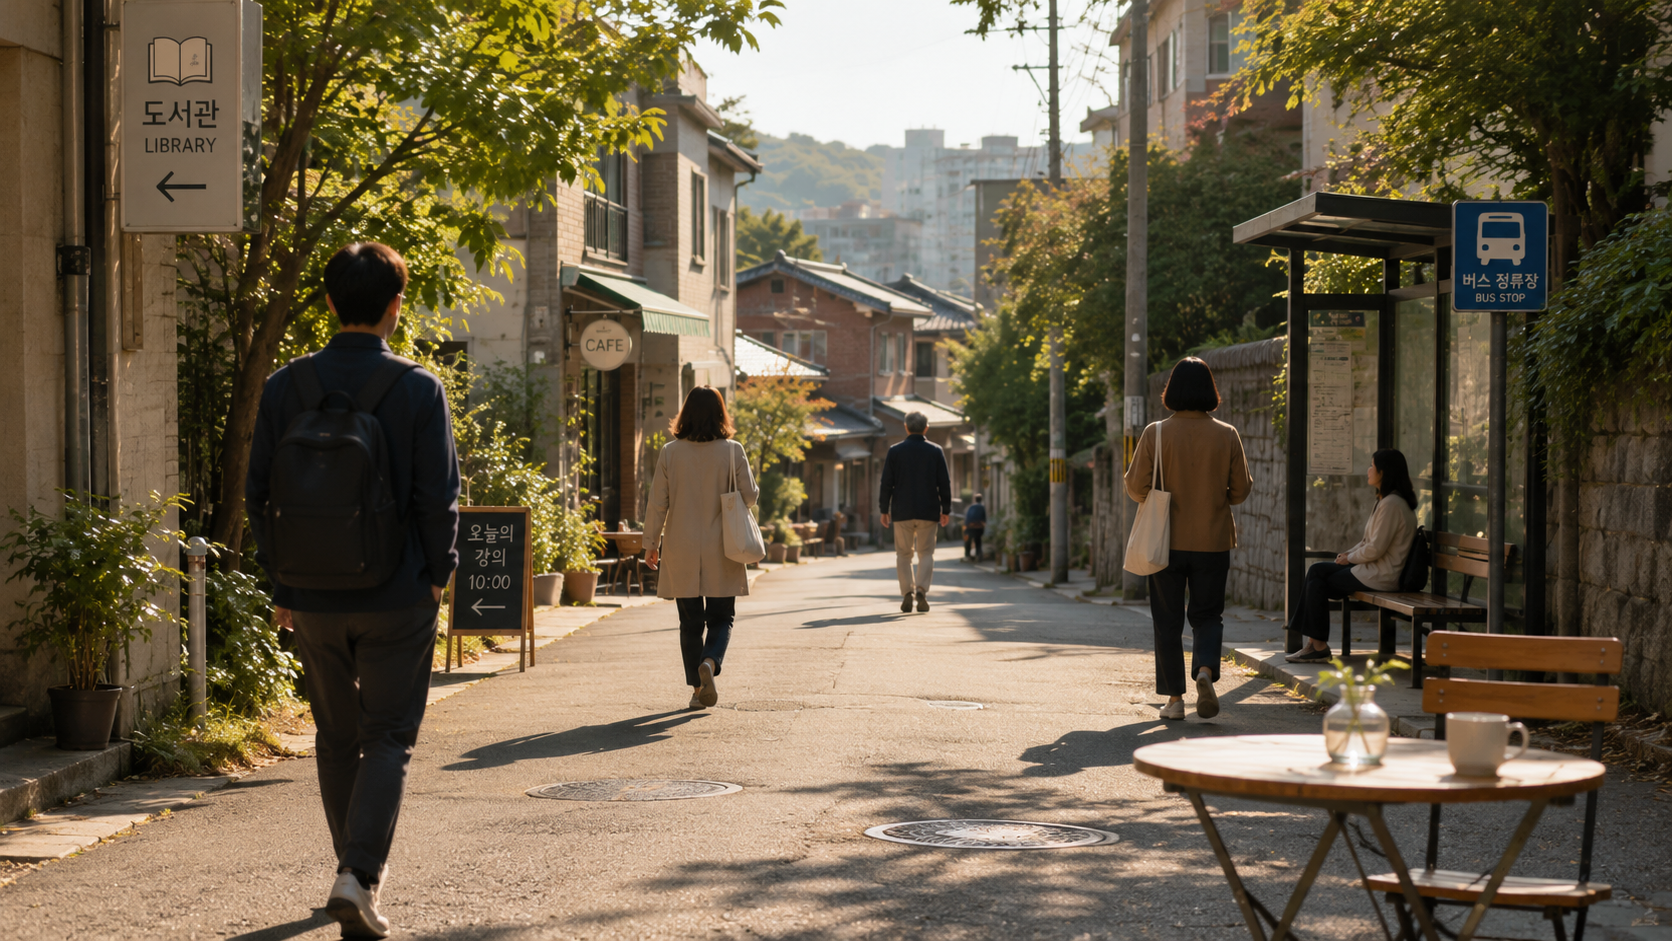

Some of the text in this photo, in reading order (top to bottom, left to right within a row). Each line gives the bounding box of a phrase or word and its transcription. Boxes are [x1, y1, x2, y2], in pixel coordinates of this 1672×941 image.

[142, 99, 220, 129] 도서관
[145, 137, 217, 154] LIBRARY
[1462, 272, 1539, 290] 버스 정류장
[1475, 292, 1526, 303] BUS STOP
[585, 338, 624, 352] CAFE
[467, 523, 514, 544] 오늘의
[475, 547, 506, 568] 강의
[468, 574, 511, 590] 10:00
